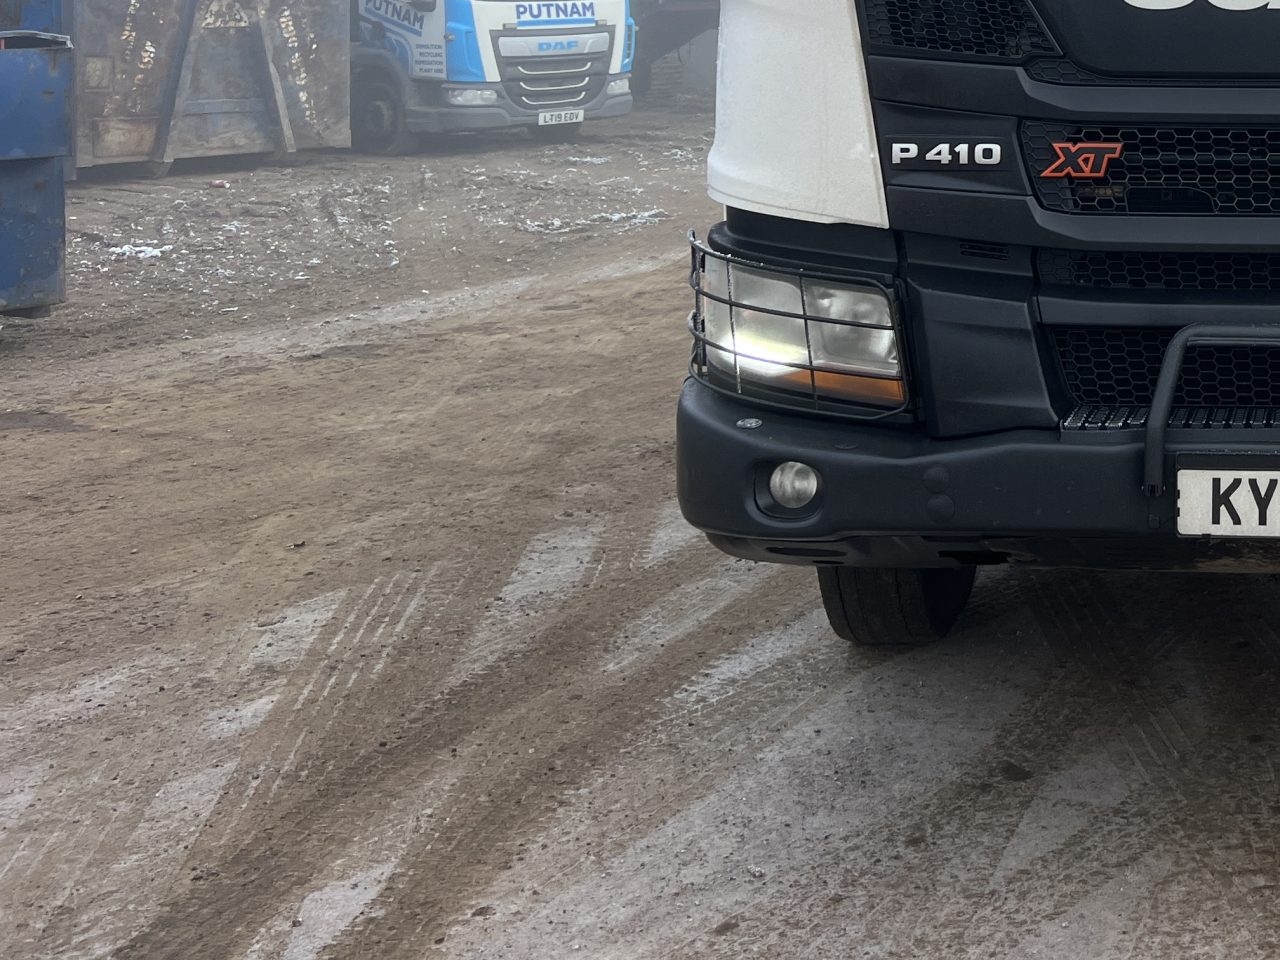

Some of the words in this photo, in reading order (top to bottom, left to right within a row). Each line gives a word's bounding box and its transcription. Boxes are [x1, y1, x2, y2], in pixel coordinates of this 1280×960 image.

[516, 2, 595, 19] PUTNAM
[537, 41, 578, 52] DAF
[891, 143, 919, 165] P
[925, 143, 1001, 165] 410
[1039, 142, 1124, 178] XT
